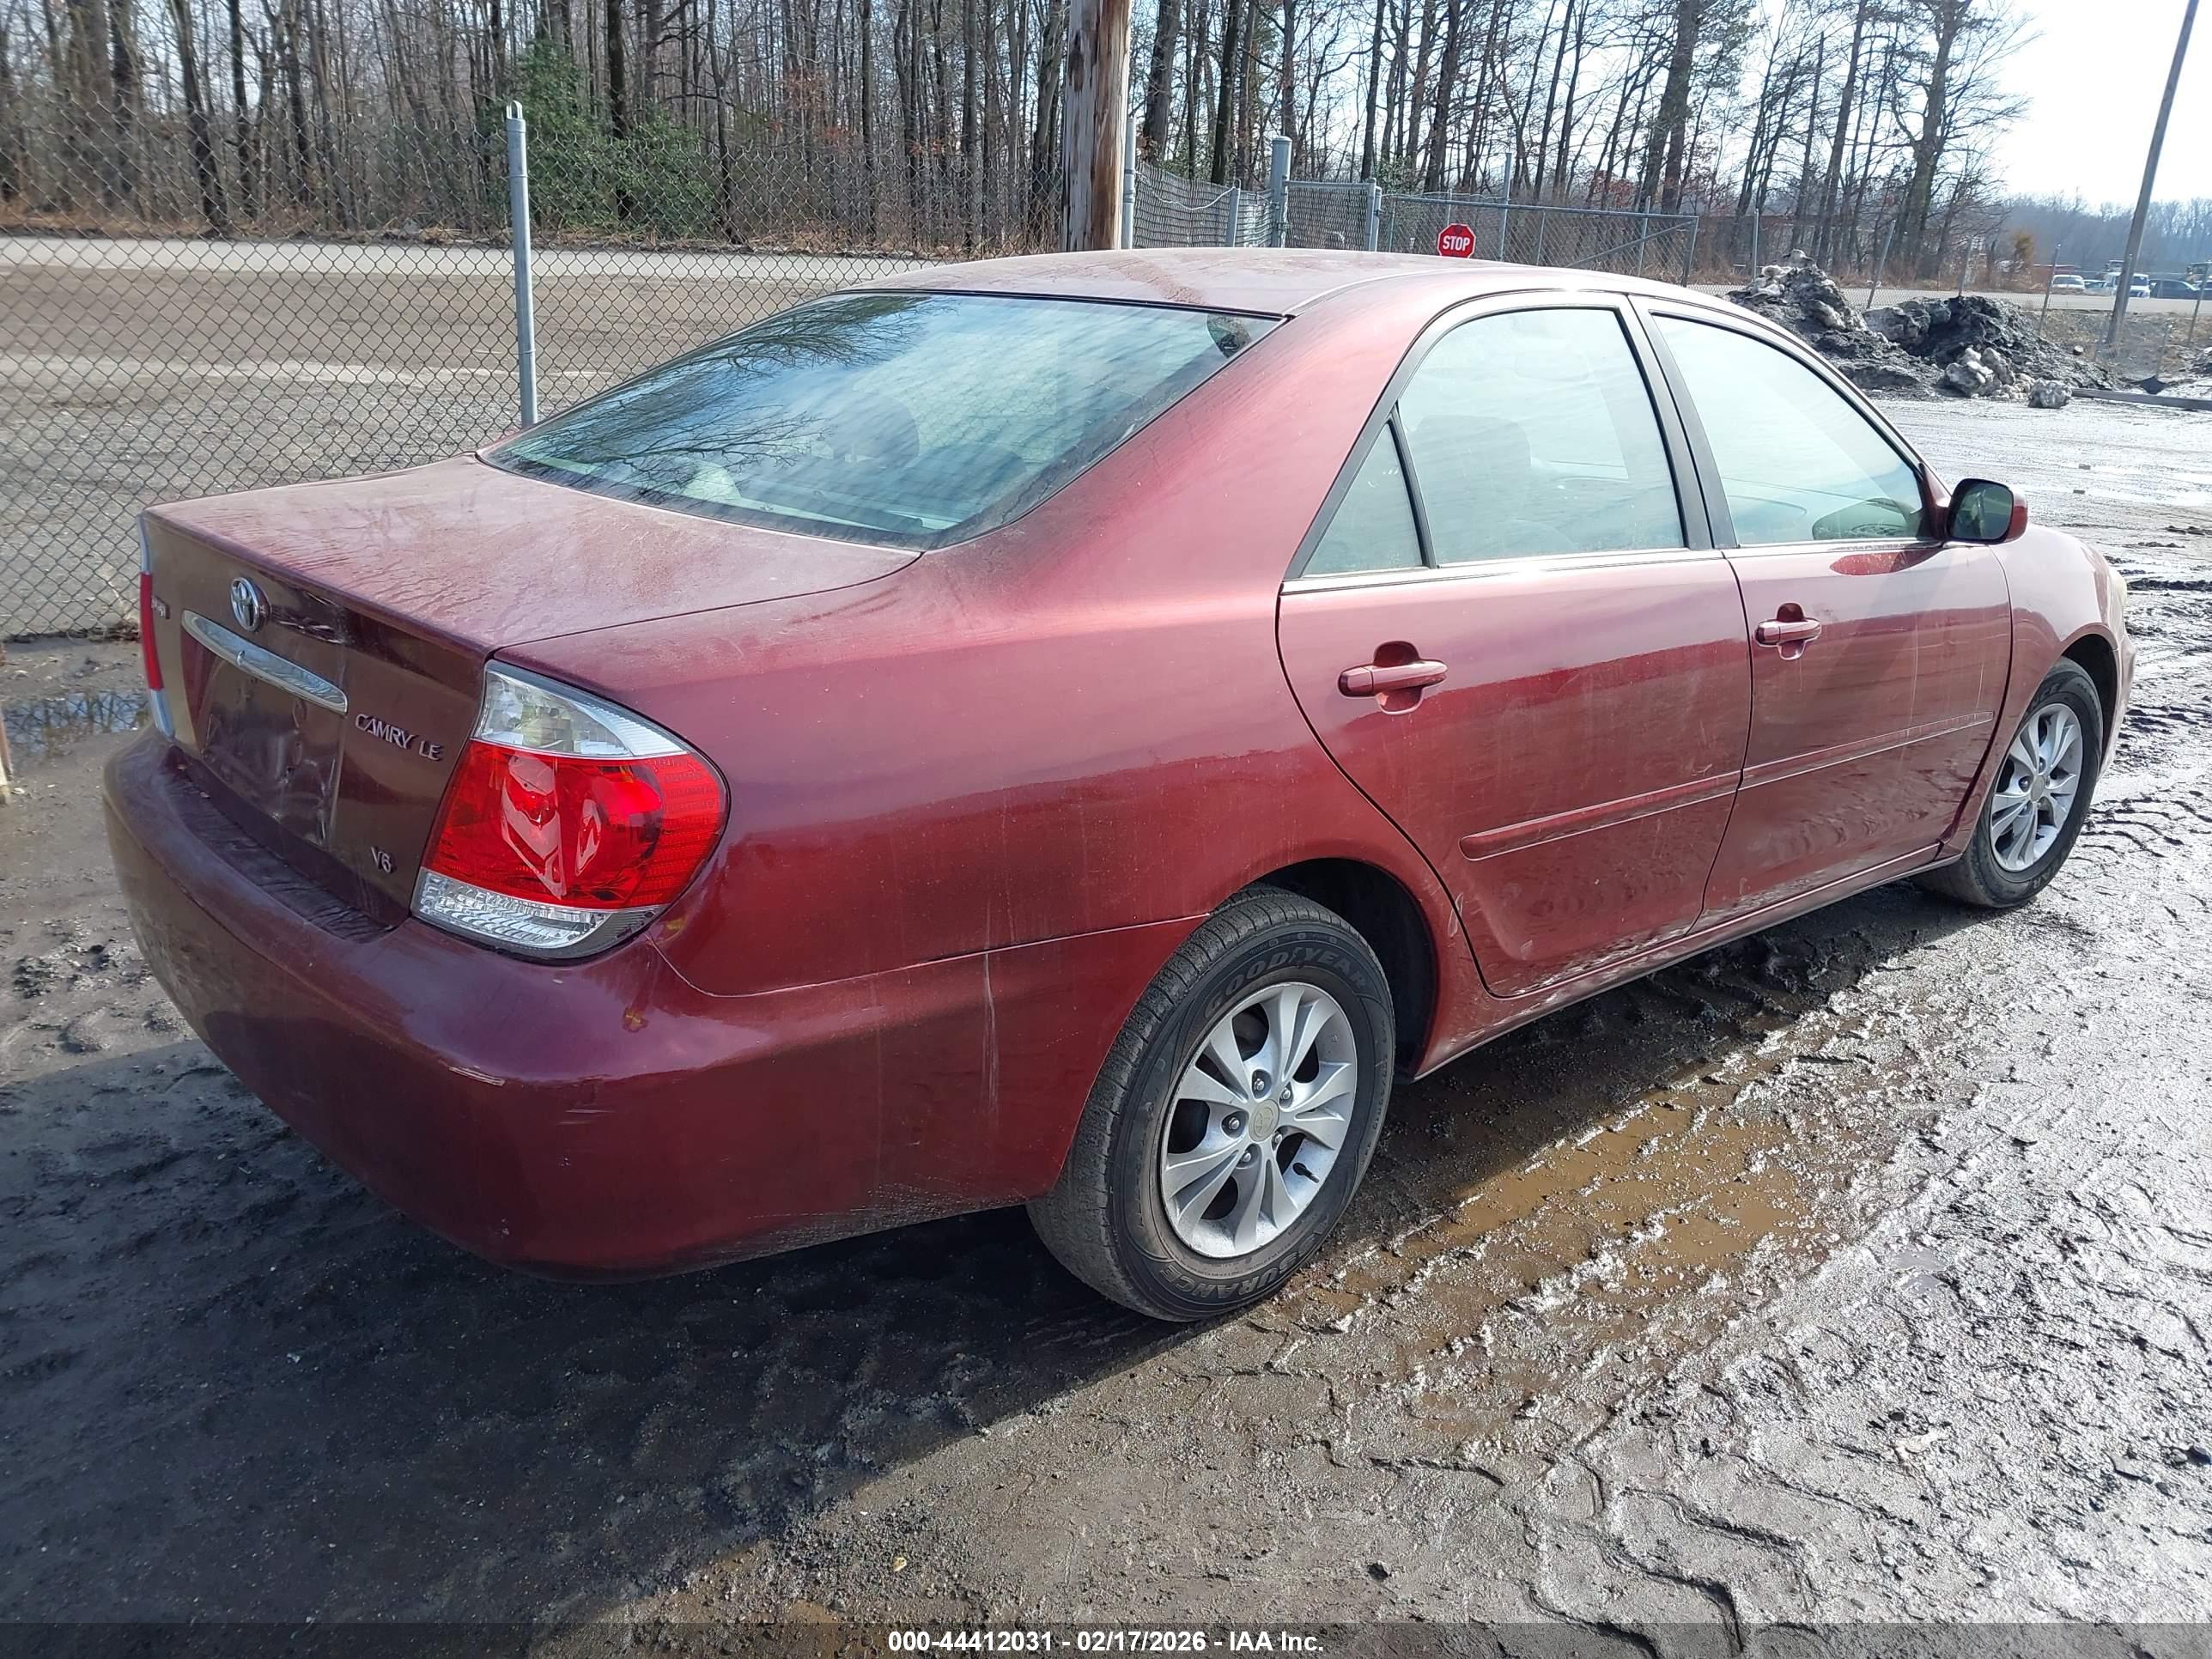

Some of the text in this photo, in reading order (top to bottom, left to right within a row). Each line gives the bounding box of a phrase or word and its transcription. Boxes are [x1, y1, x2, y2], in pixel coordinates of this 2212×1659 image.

[1443, 236, 1470, 251] STOP
[355, 714, 442, 761] CAMRY LE
[371, 847, 393, 873] V6
[1204, 946, 1368, 1019] GOODYEAR
